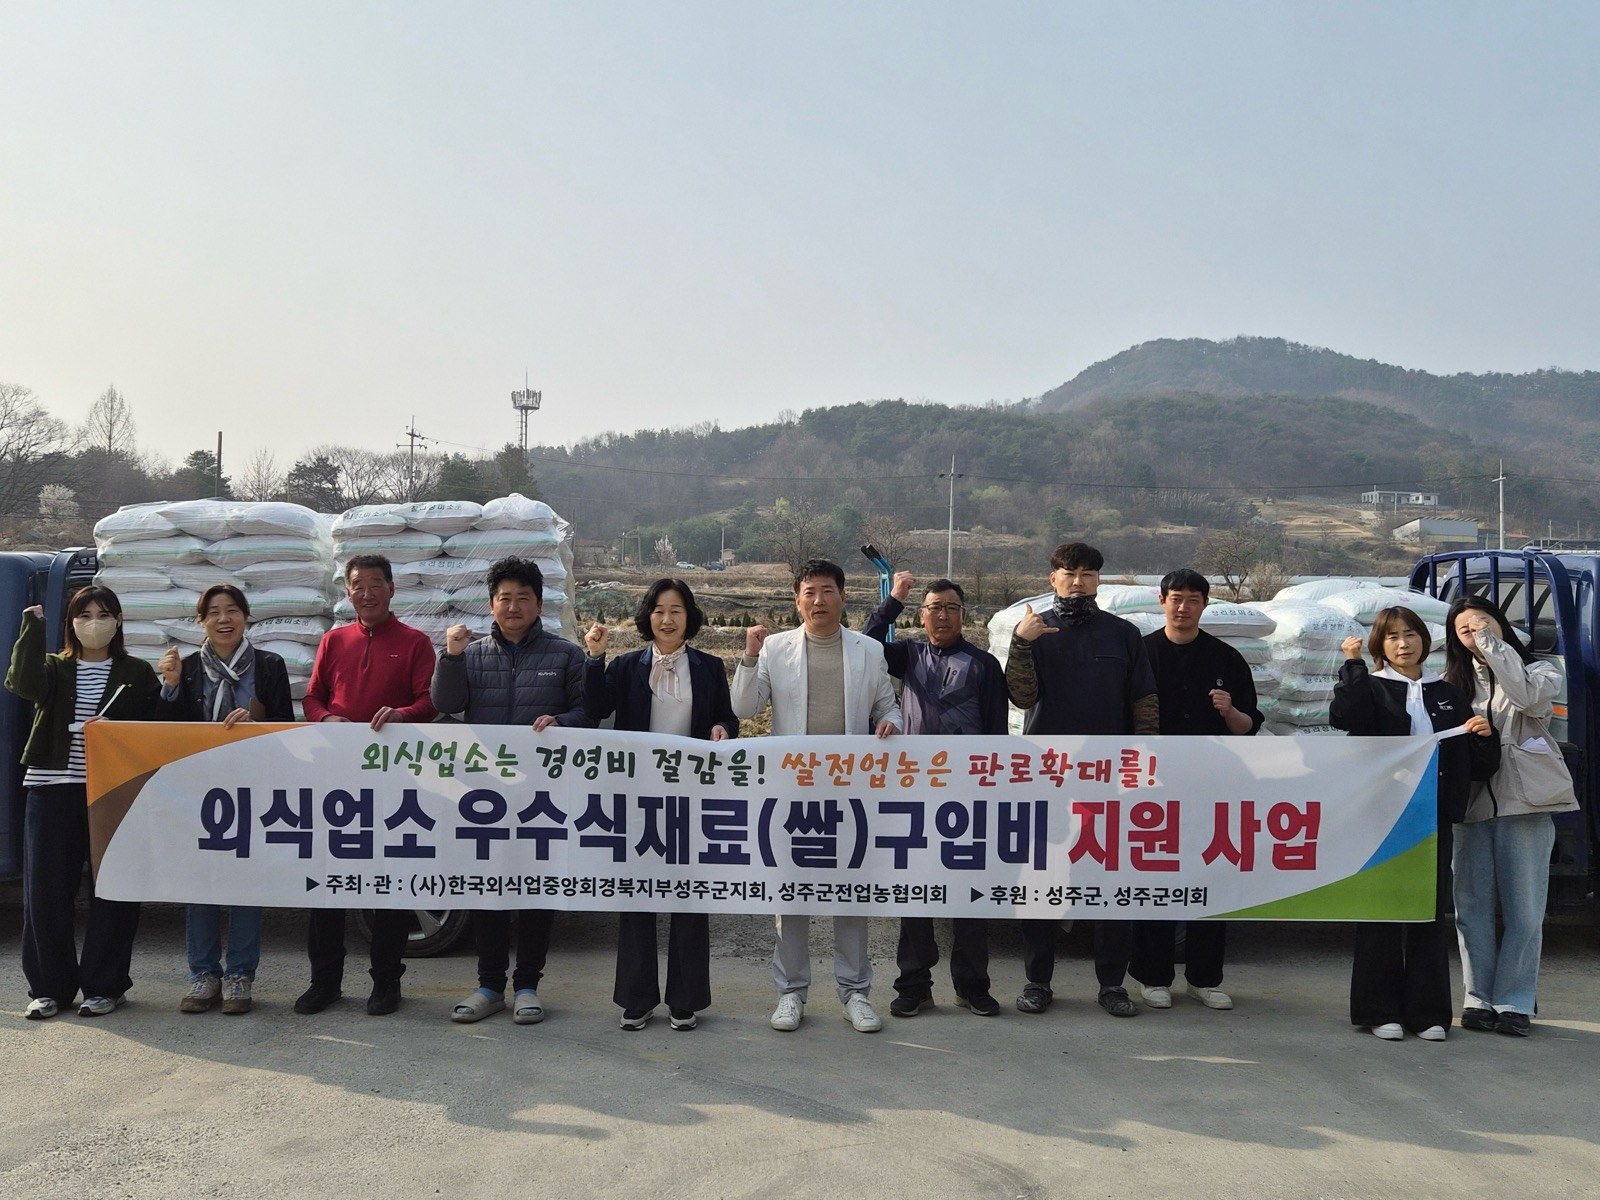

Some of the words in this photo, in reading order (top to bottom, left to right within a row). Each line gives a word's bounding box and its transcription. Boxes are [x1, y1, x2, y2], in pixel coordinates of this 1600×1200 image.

[360, 740, 519, 778] 외식업소는
[536, 745, 636, 780] 경영비
[652, 748, 767, 787] 절감을!
[782, 751, 952, 788] 쌀전업농은
[969, 748, 1157, 788] 판로확대를!
[198, 788, 437, 860] 외식업소
[454, 790, 1049, 872] 우수식재료(쌀)구입비
[1068, 800, 1181, 872] 지원
[1202, 801, 1321, 872] 사업
[326, 875, 391, 895] 주최·관
[411, 874, 773, 902] (사)한국외식업중앙회경북지부성주군지회,
[778, 881, 947, 905] 성주군전업농협의회
[990, 885, 1027, 906] 후원
[1046, 886, 1109, 907] 성주군,
[1114, 886, 1208, 907] 성주군의회
